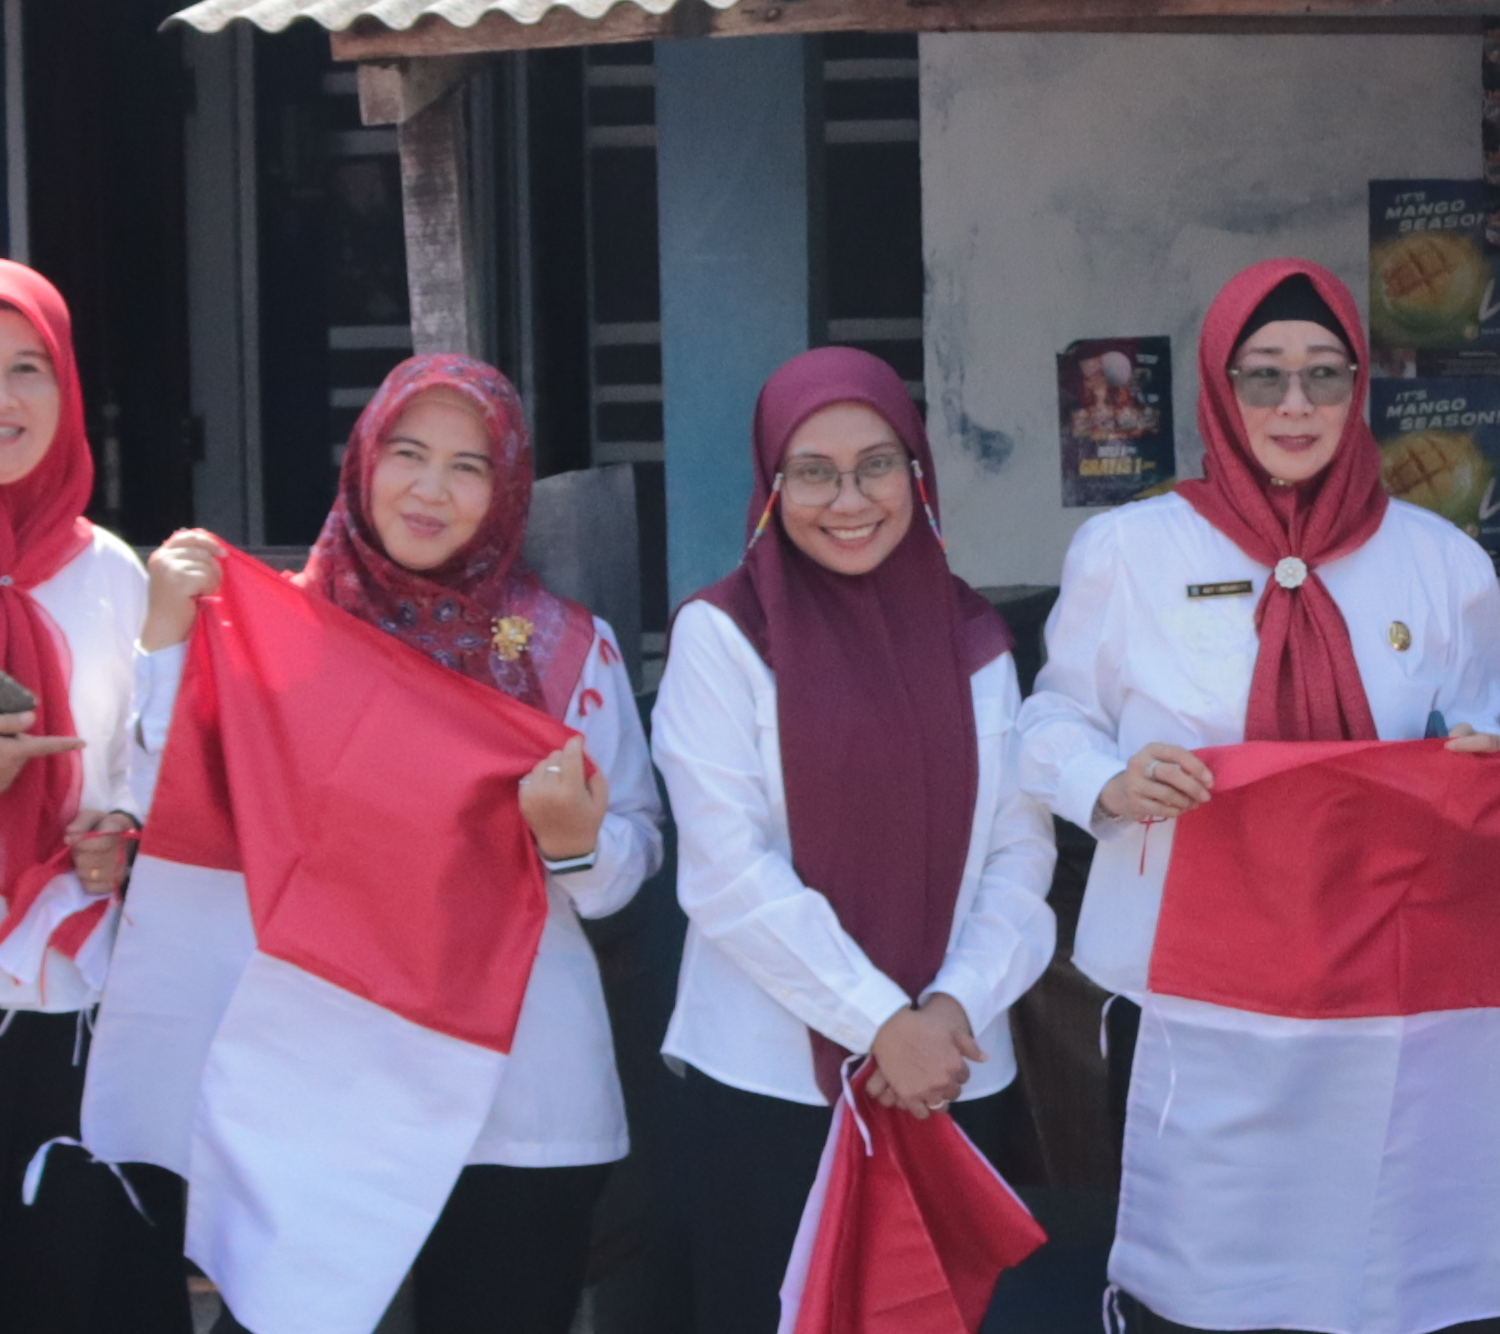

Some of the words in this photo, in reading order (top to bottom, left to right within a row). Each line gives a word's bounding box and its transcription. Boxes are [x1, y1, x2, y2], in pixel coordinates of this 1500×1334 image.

[1385, 199, 1466, 220] MANGO
[1398, 213, 1484, 233] SEASO
[1386, 397, 1467, 419] MANGO
